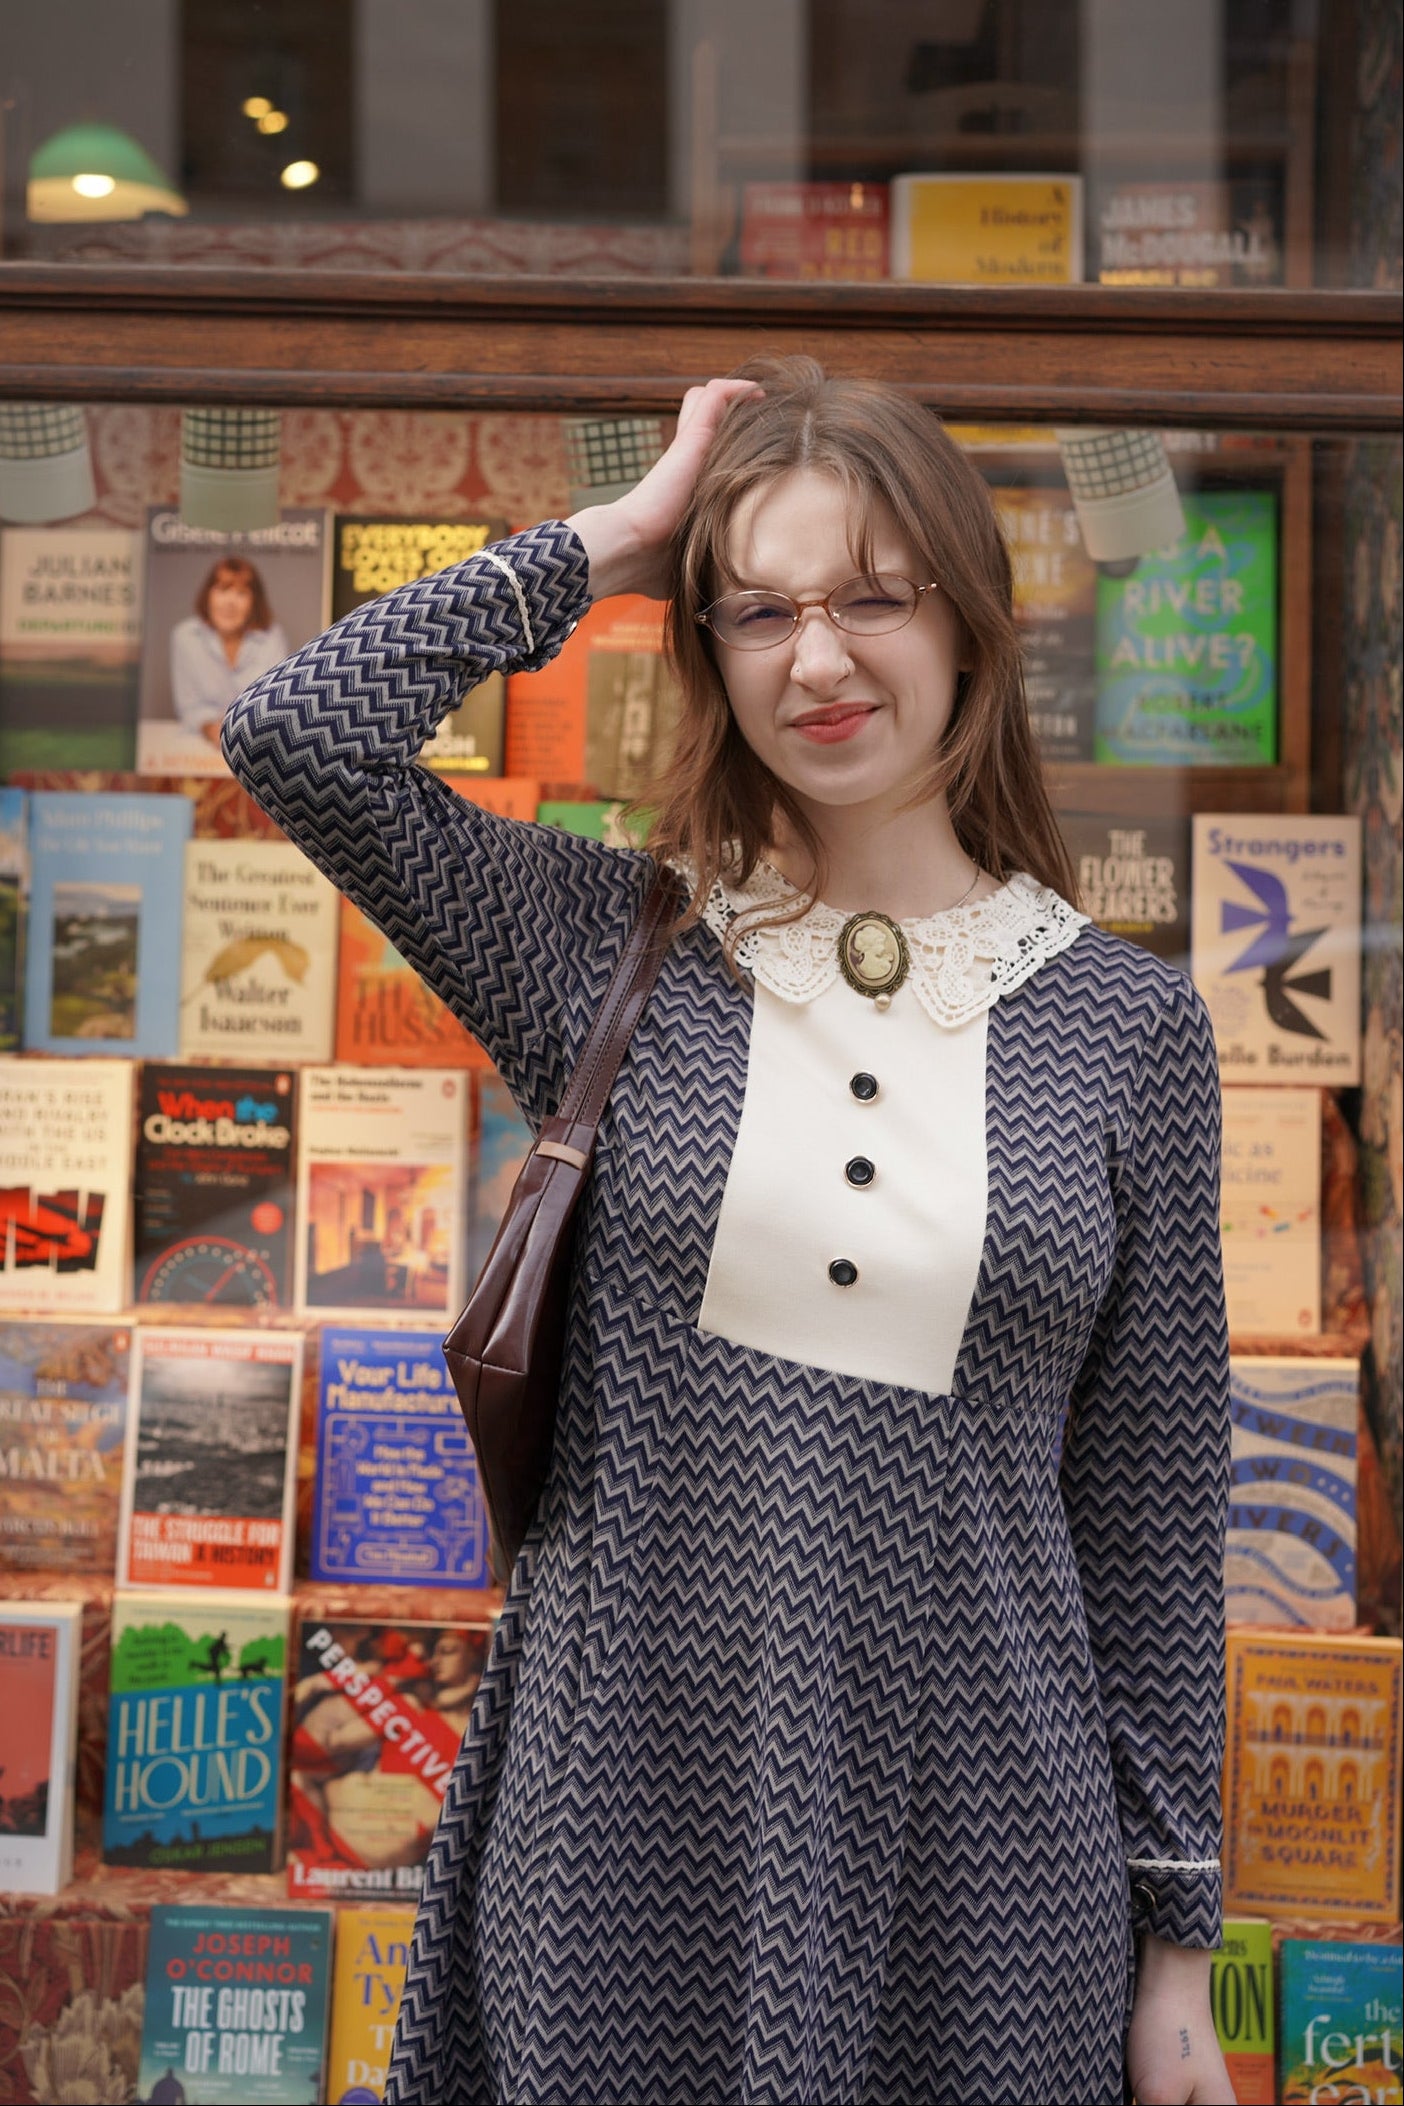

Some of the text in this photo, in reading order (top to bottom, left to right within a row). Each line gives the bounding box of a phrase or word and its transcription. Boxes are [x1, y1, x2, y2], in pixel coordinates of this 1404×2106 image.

[29, 556, 133, 579] JULIAN
[22, 582, 136, 605] BARNES
[1123, 577, 1245, 615] RIVER
[1111, 632, 1256, 670] ALIVE?
[1208, 828, 1347, 864] Strangers
[1079, 855, 1175, 890] FLOWER
[213, 978, 290, 1006] Walter
[199, 1006, 303, 1034] Isaacson
[1267, 1043, 1351, 1067] Burden
[157, 1090, 279, 1123] When the
[144, 1113, 291, 1149] Clock Broke
[337, 1359, 396, 1387] Your
[396, 1361, 442, 1390] Life
[132, 1517, 282, 1547] THE STRUGGLE FOR
[211, 1545, 276, 1566] HISTORY
[1305, 1674, 1380, 1695] WATERS
[117, 1685, 274, 1758] HELLE'S
[114, 1747, 272, 1812] HOUND
[1260, 1801, 1364, 1826] MURDER
[1266, 1823, 1370, 1848] MOONLIT
[1260, 1845, 1359, 1871] SQUARE
[294, 1862, 393, 1888] Laurent
[193, 1933, 292, 1957] JOSEPH
[165, 1957, 313, 1985] O'CONNOR
[171, 1986, 307, 2034] THE GHOSTS
[1364, 1998, 1401, 2023] the
[184, 2031, 216, 2076] OF
[217, 2033, 286, 2077] ROME
